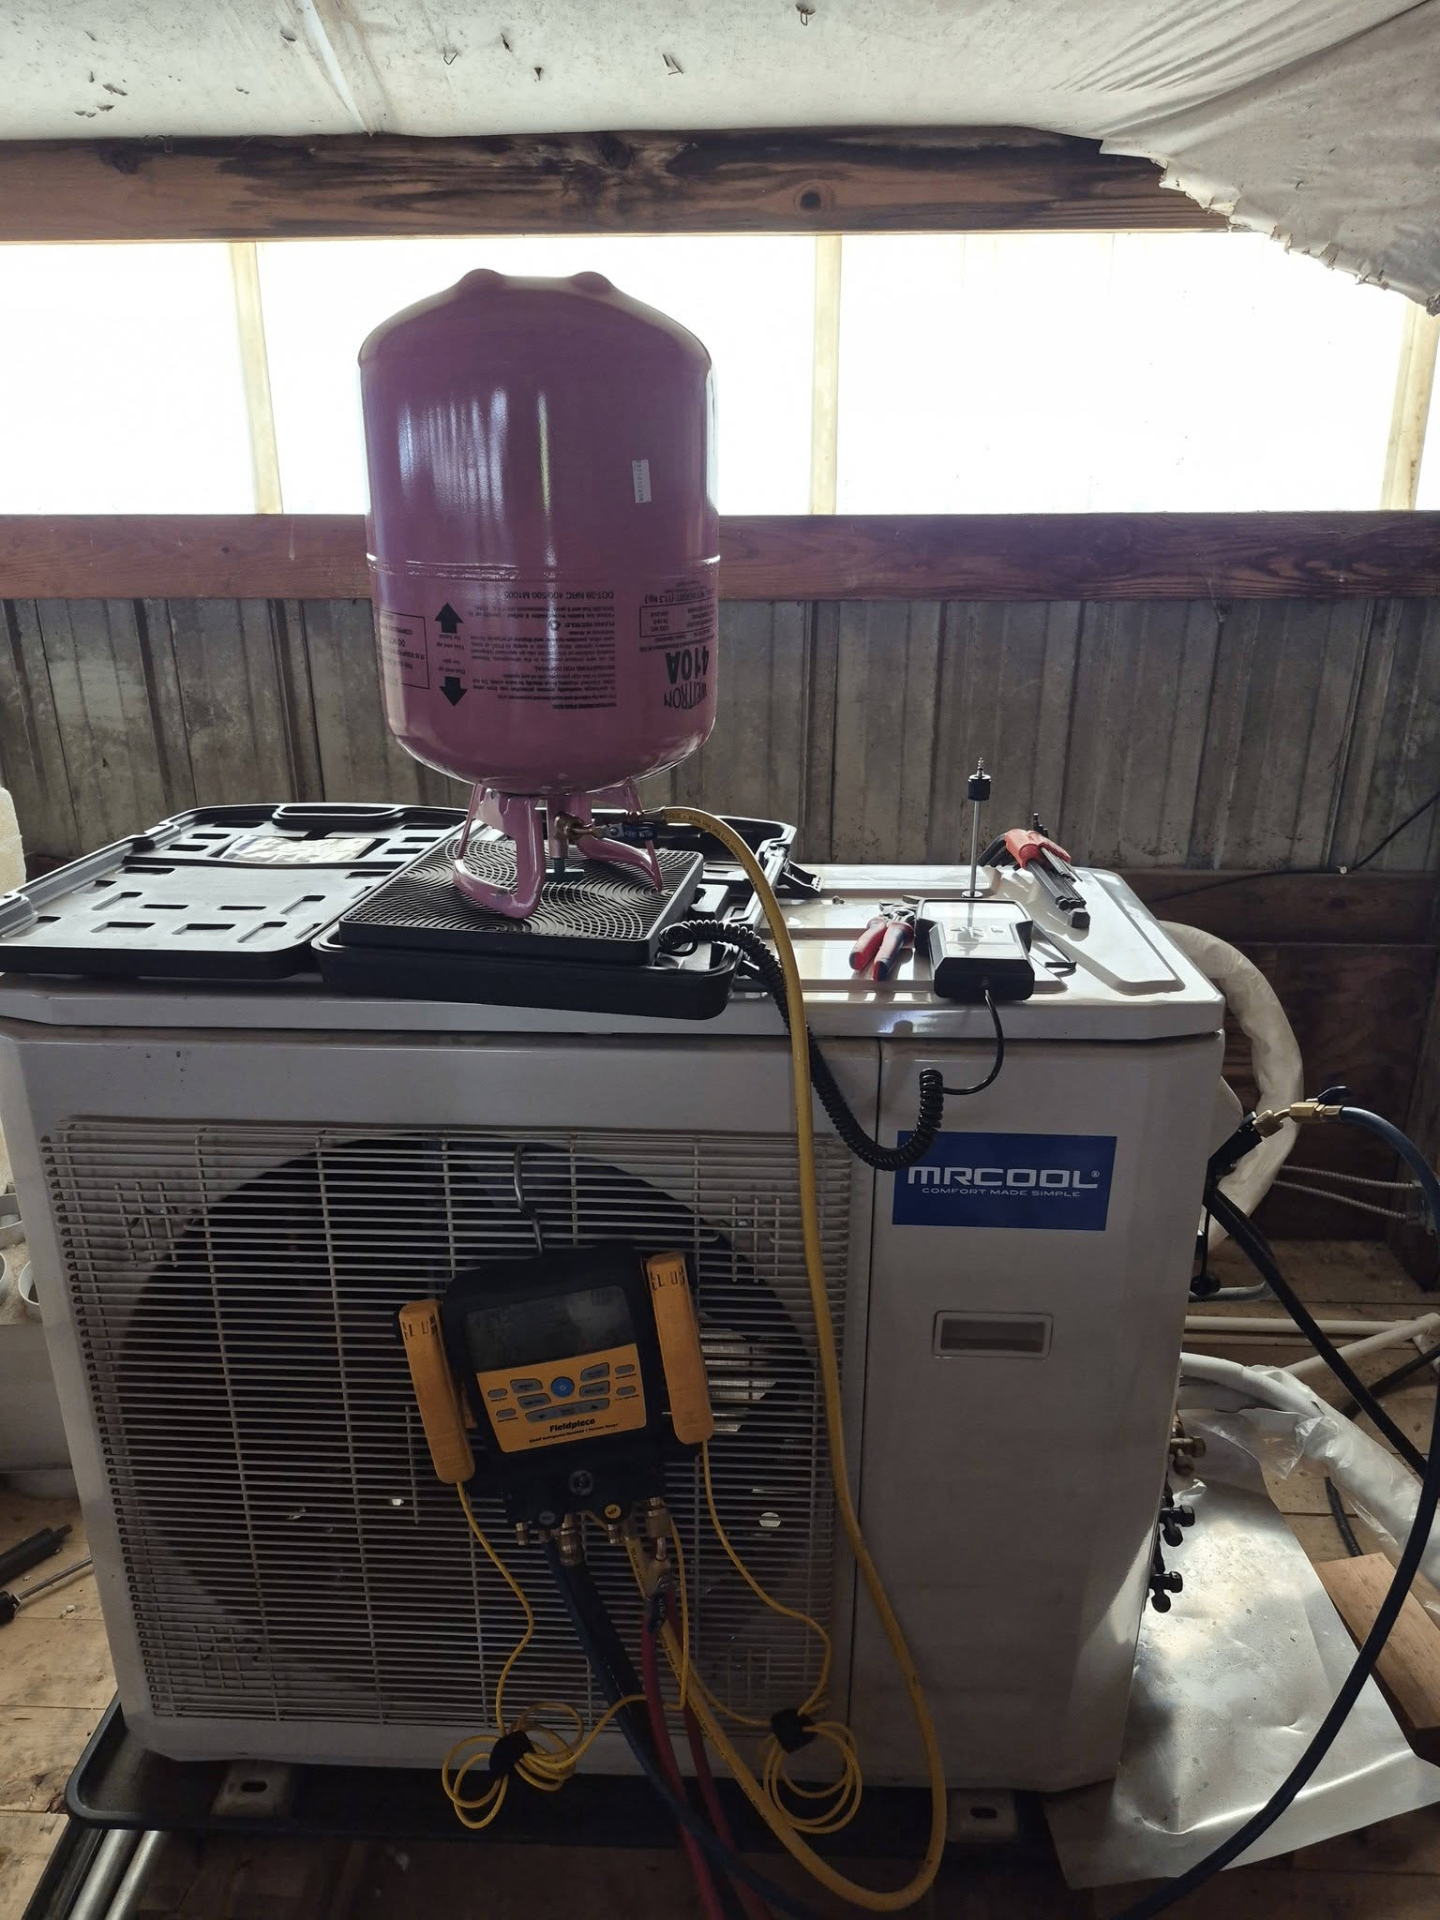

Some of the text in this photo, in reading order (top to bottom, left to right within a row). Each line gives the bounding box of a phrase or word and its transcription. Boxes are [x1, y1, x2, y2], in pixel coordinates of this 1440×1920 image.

[586, 591, 614, 599] DOT-39
[664, 646, 708, 684] 410A
[907, 1166, 1098, 1189] MRCOOL
[922, 1187, 987, 1195] COMFORT
[549, 1417, 596, 1433] Fieldpiece
